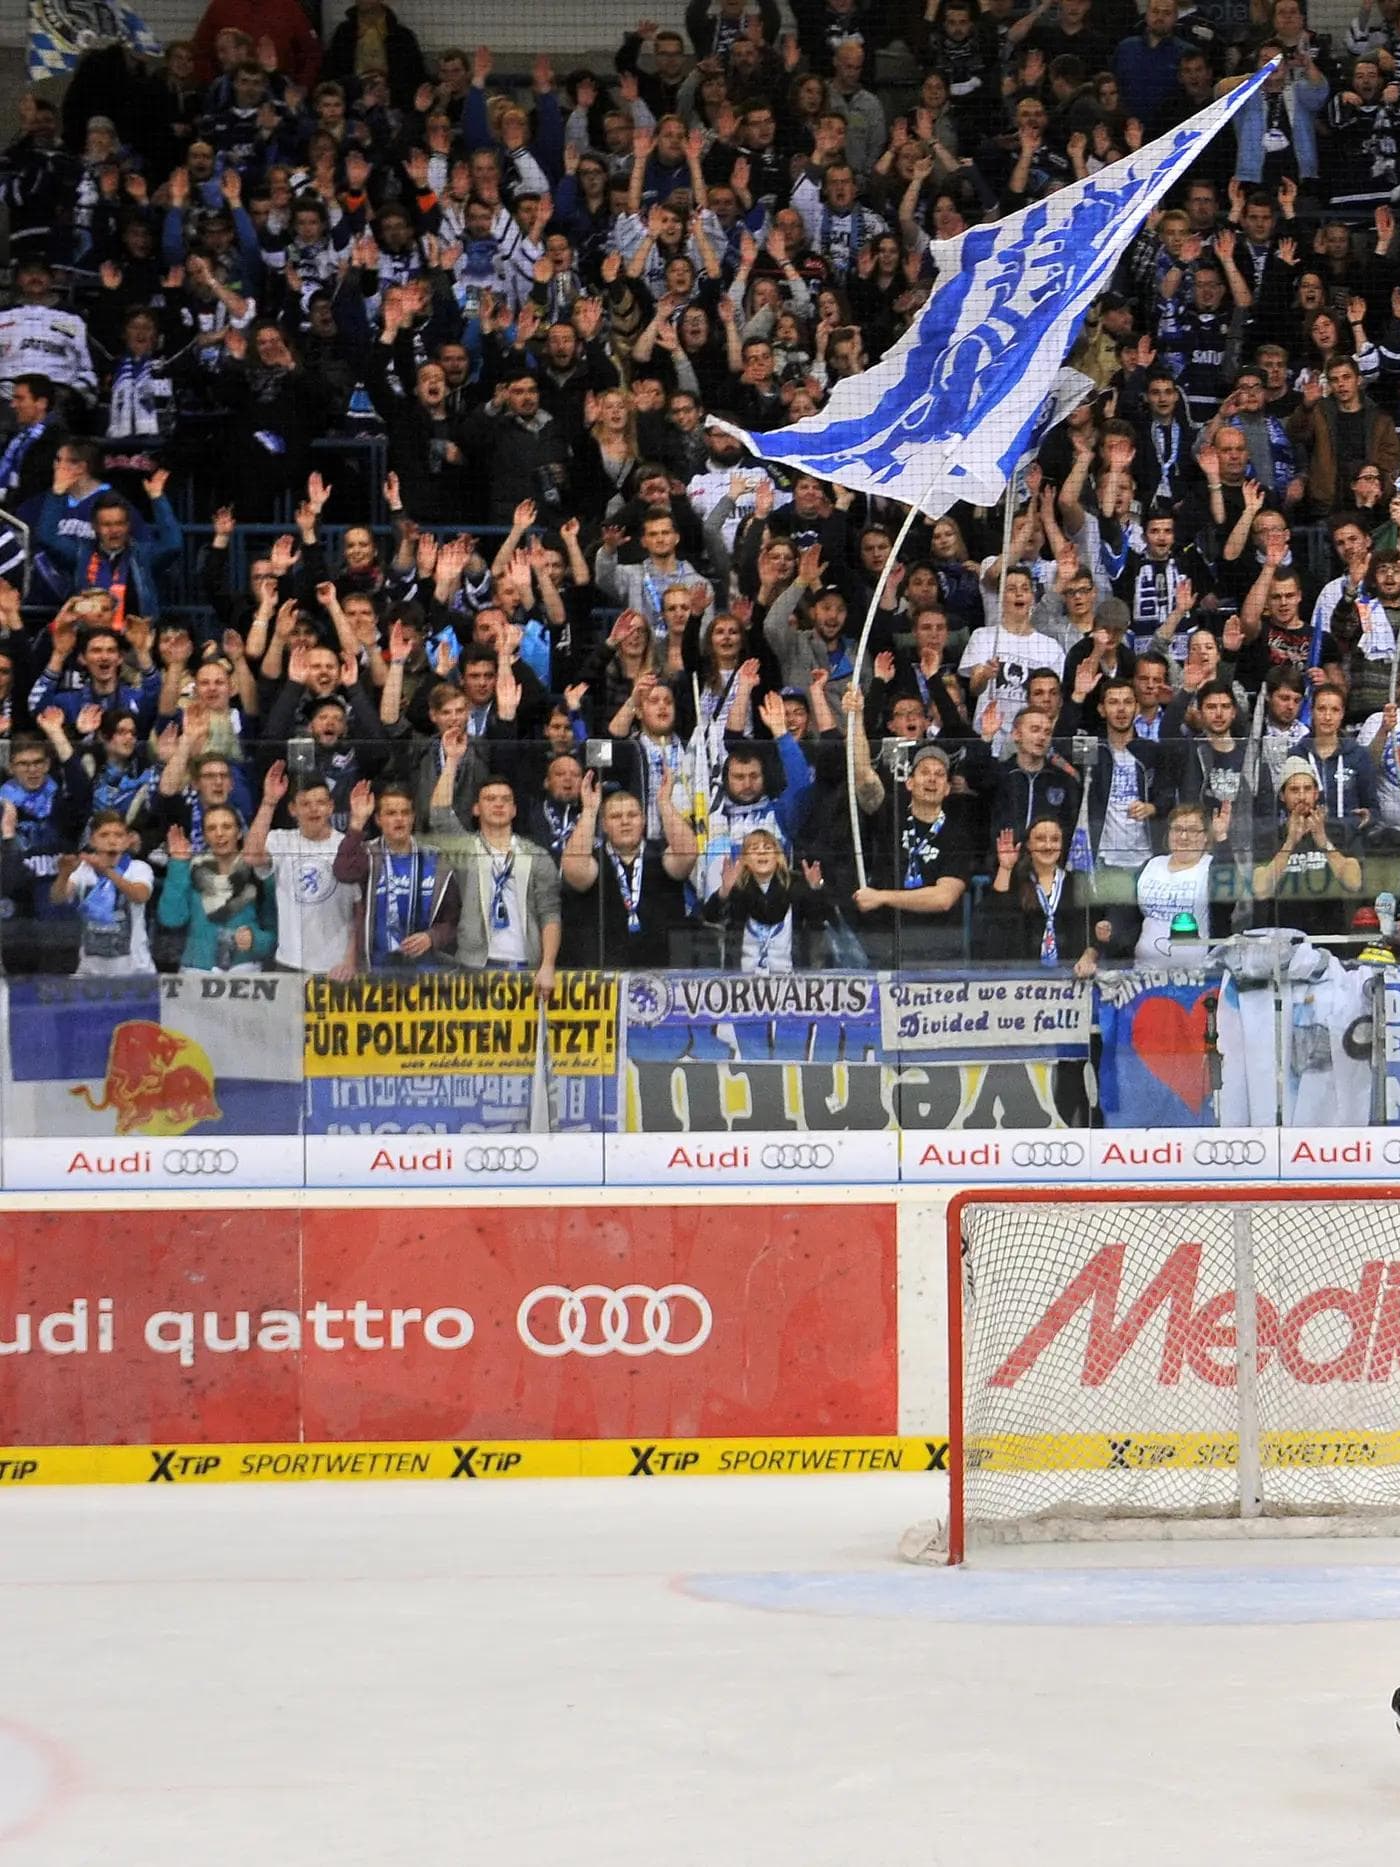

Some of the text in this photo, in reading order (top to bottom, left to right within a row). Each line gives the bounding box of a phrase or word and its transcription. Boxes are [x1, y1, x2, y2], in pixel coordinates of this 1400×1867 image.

[1192, 350, 1224, 366] SATU
[201, 978, 279, 1002] DEN
[889, 983, 969, 1008] United
[978, 986, 1007, 1001] we
[1014, 980, 1086, 1000] stand!
[897, 1009, 1080, 1038] Divided we fall!
[357, 1021, 512, 1056] POLIZISTEN
[67, 1151, 151, 1174] Audi
[370, 1148, 453, 1171] Audi
[667, 1146, 750, 1168] Audi
[918, 1143, 1001, 1165] Audi
[1101, 1142, 1183, 1164] Audi
[1292, 1140, 1372, 1162] Audi
[144, 1300, 474, 1366] quattro
[240, 1452, 430, 1475] SPORTWETTEN
[717, 1448, 901, 1471] SPORTWETTEN
